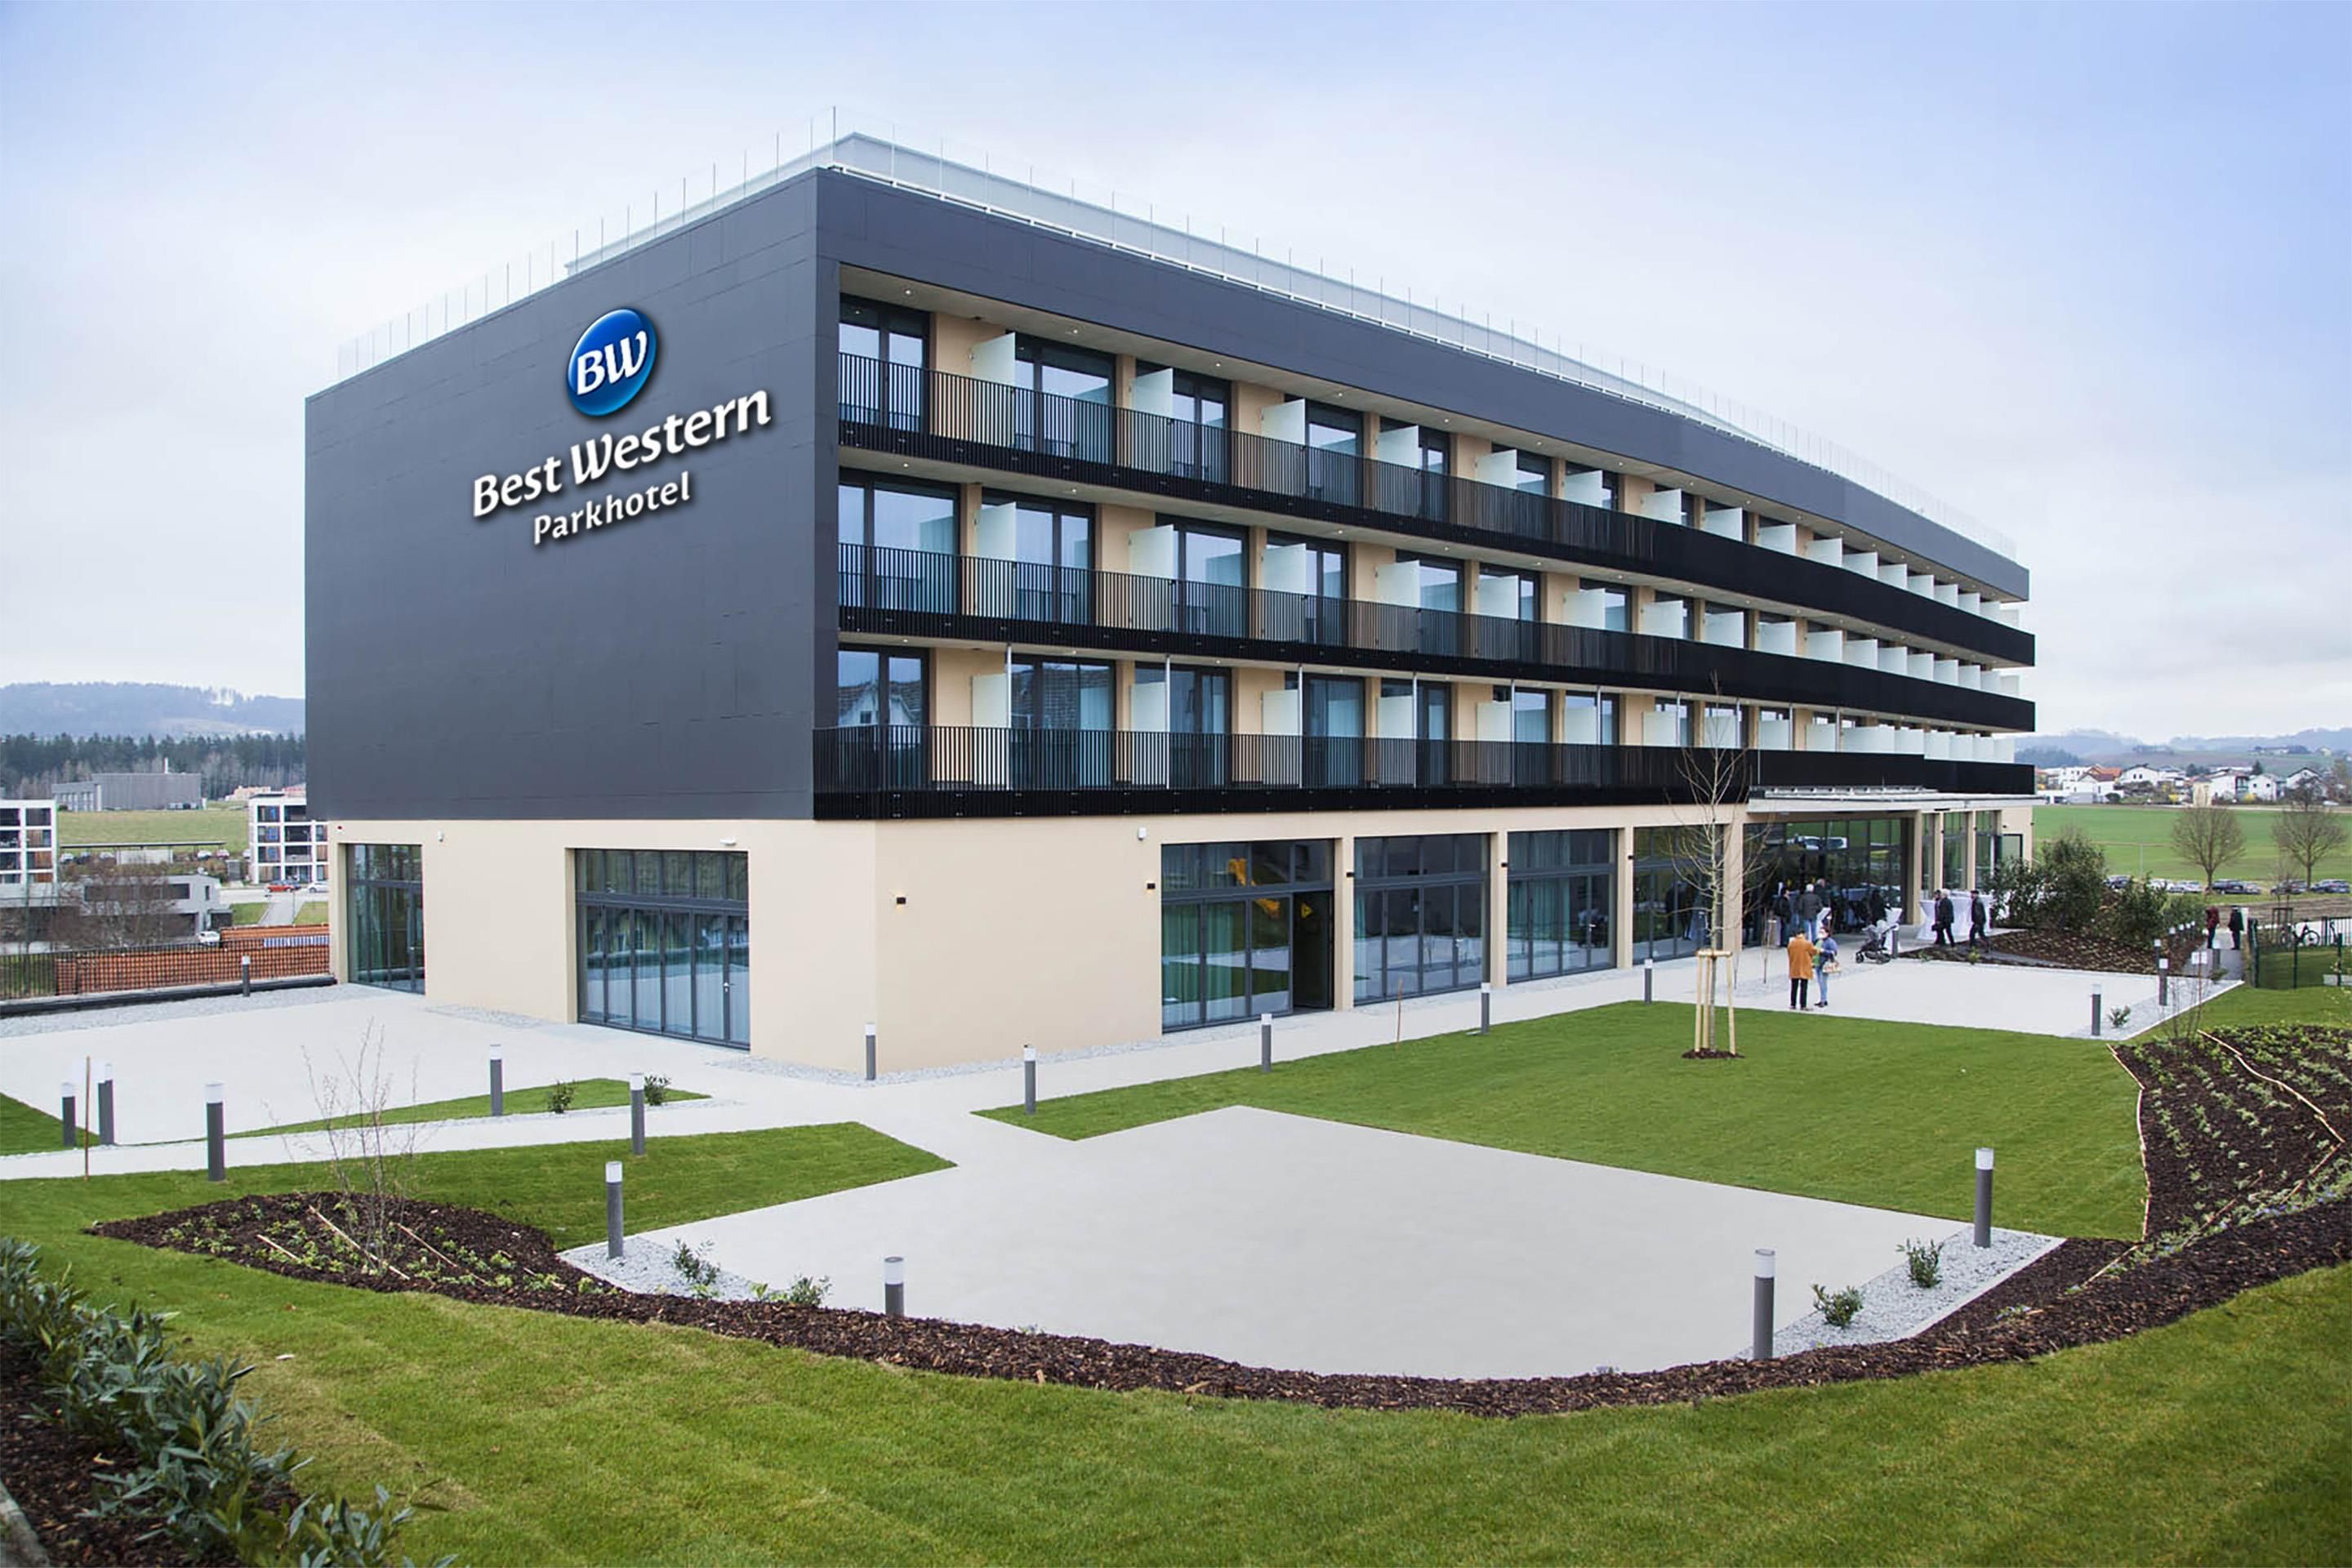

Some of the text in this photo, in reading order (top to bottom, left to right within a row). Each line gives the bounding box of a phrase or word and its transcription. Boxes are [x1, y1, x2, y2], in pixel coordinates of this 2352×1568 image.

[577, 330, 648, 395] BW
[473, 390, 771, 517] Best Western
[533, 470, 691, 545] Parkhotel
